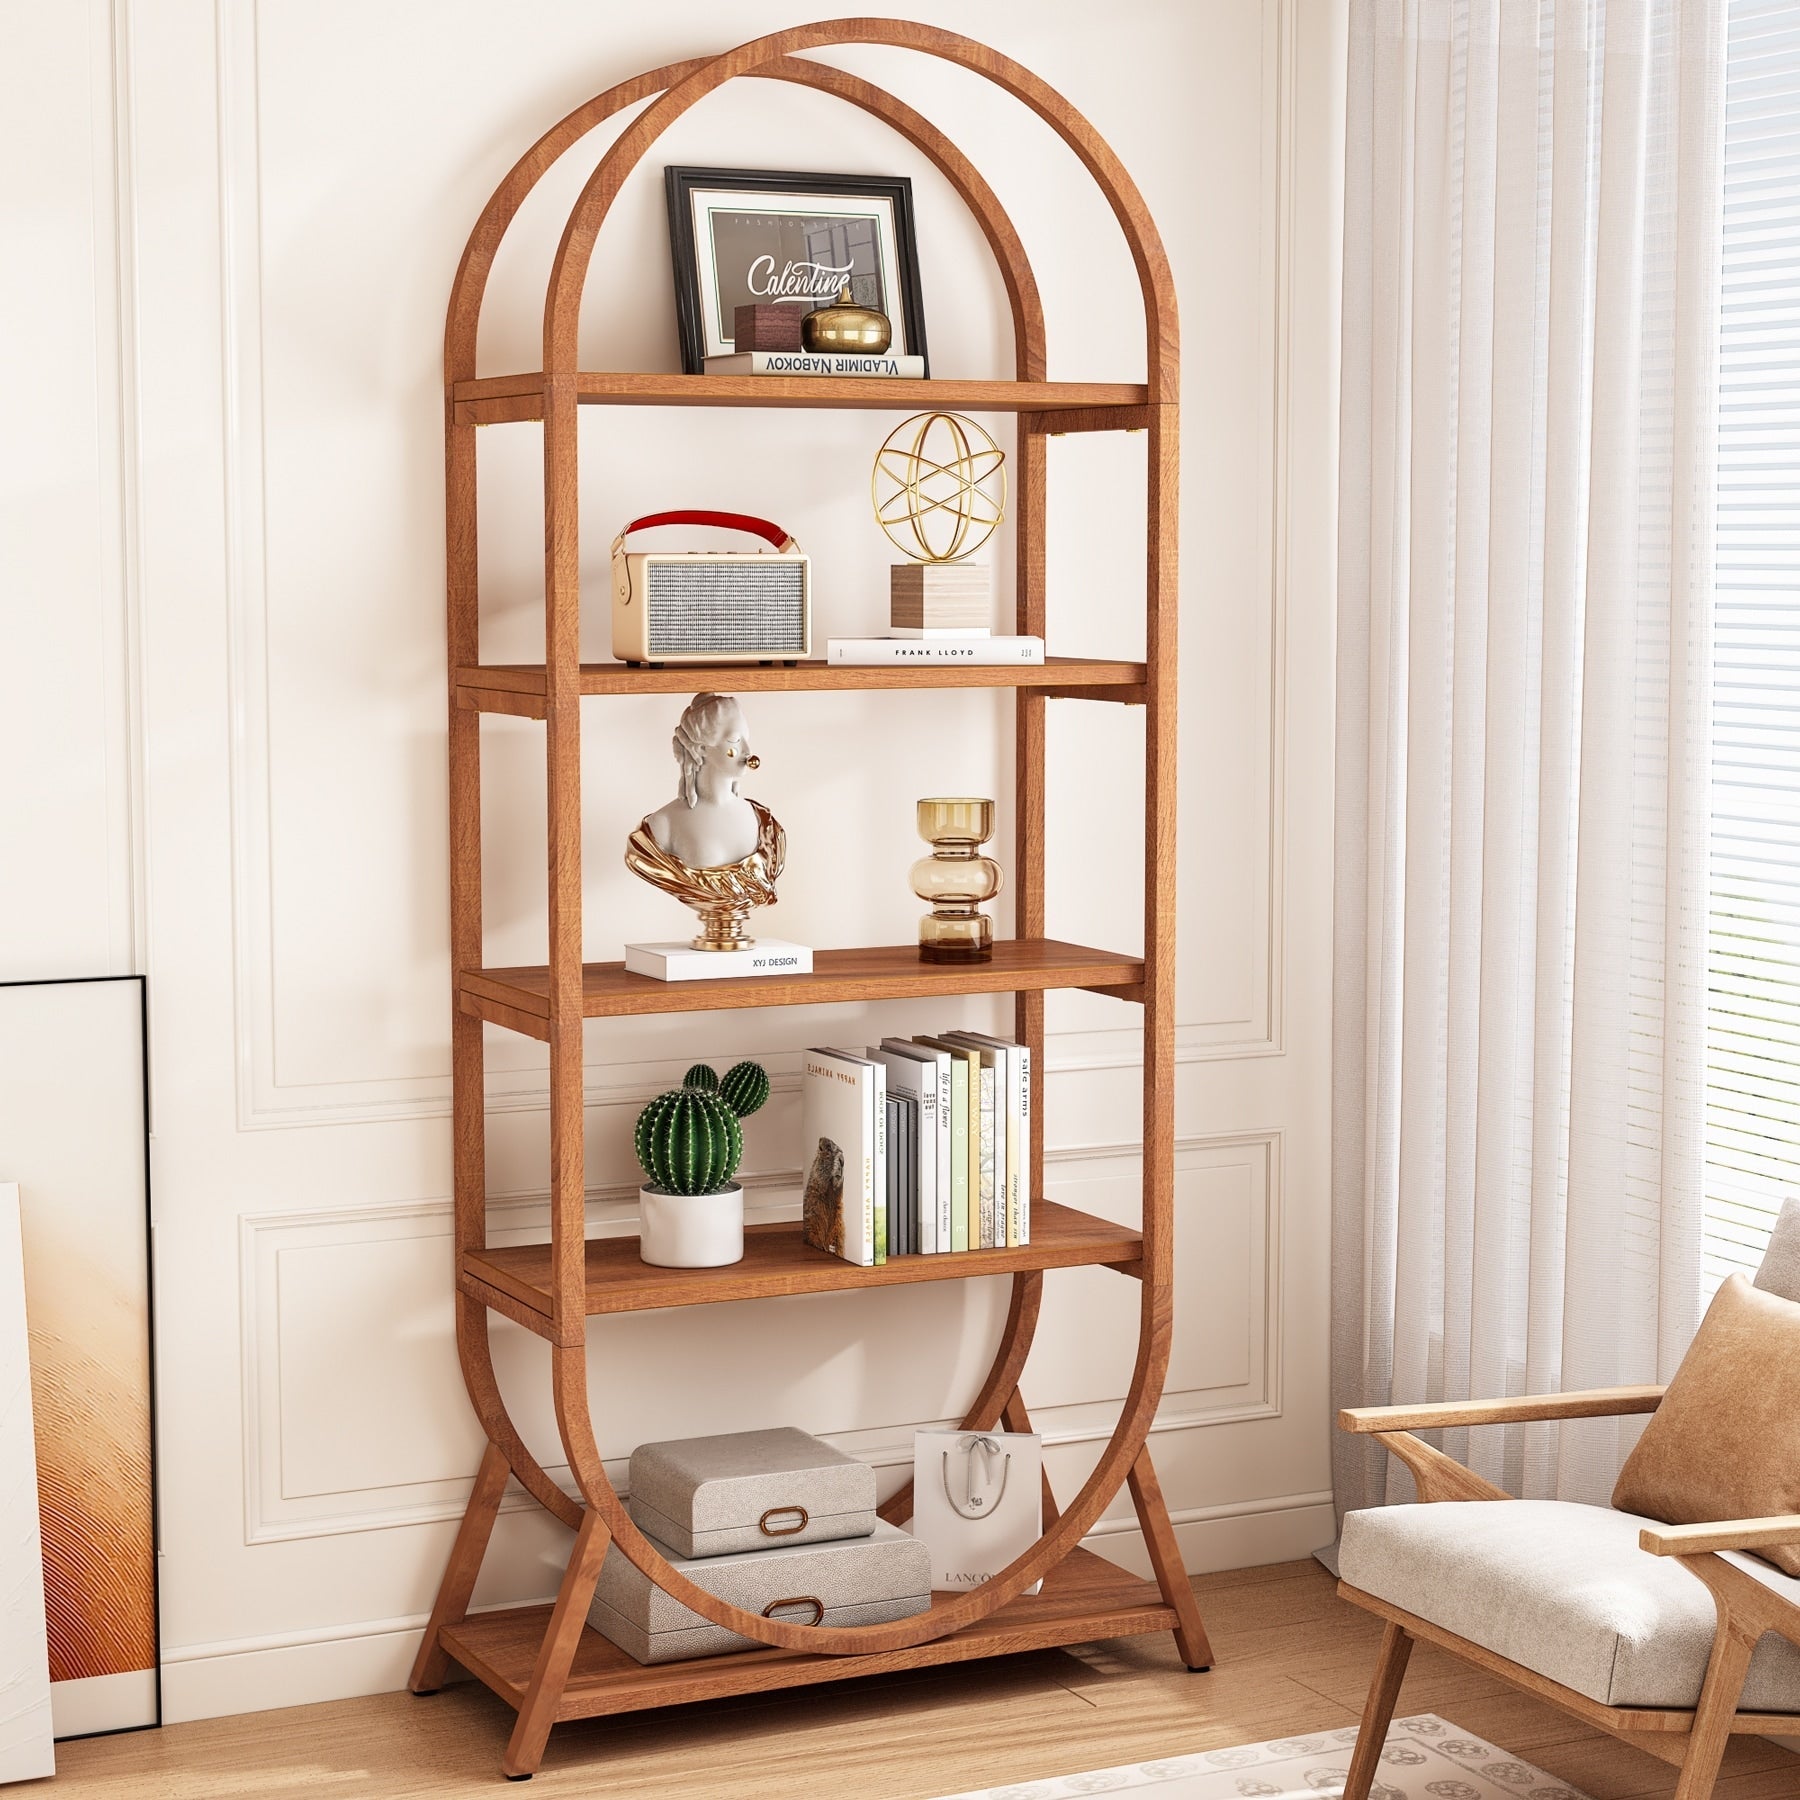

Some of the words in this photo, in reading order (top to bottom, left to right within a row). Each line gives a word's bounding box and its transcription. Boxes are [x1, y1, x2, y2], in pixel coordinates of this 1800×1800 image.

[766, 356, 832, 374] NABOKOV
[835, 359, 899, 375] VLADIMIR
[769, 957, 797, 967] DESIGN
[939, 1072, 950, 1086] life
[1022, 1058, 1030, 1083] safe
[971, 1061, 979, 1102] YOUR
[939, 1104, 950, 1129] flower
[971, 1106, 979, 1136] WAY
[956, 1079, 965, 1233] HOME
[945, 1571, 996, 1583] LANCÔ
